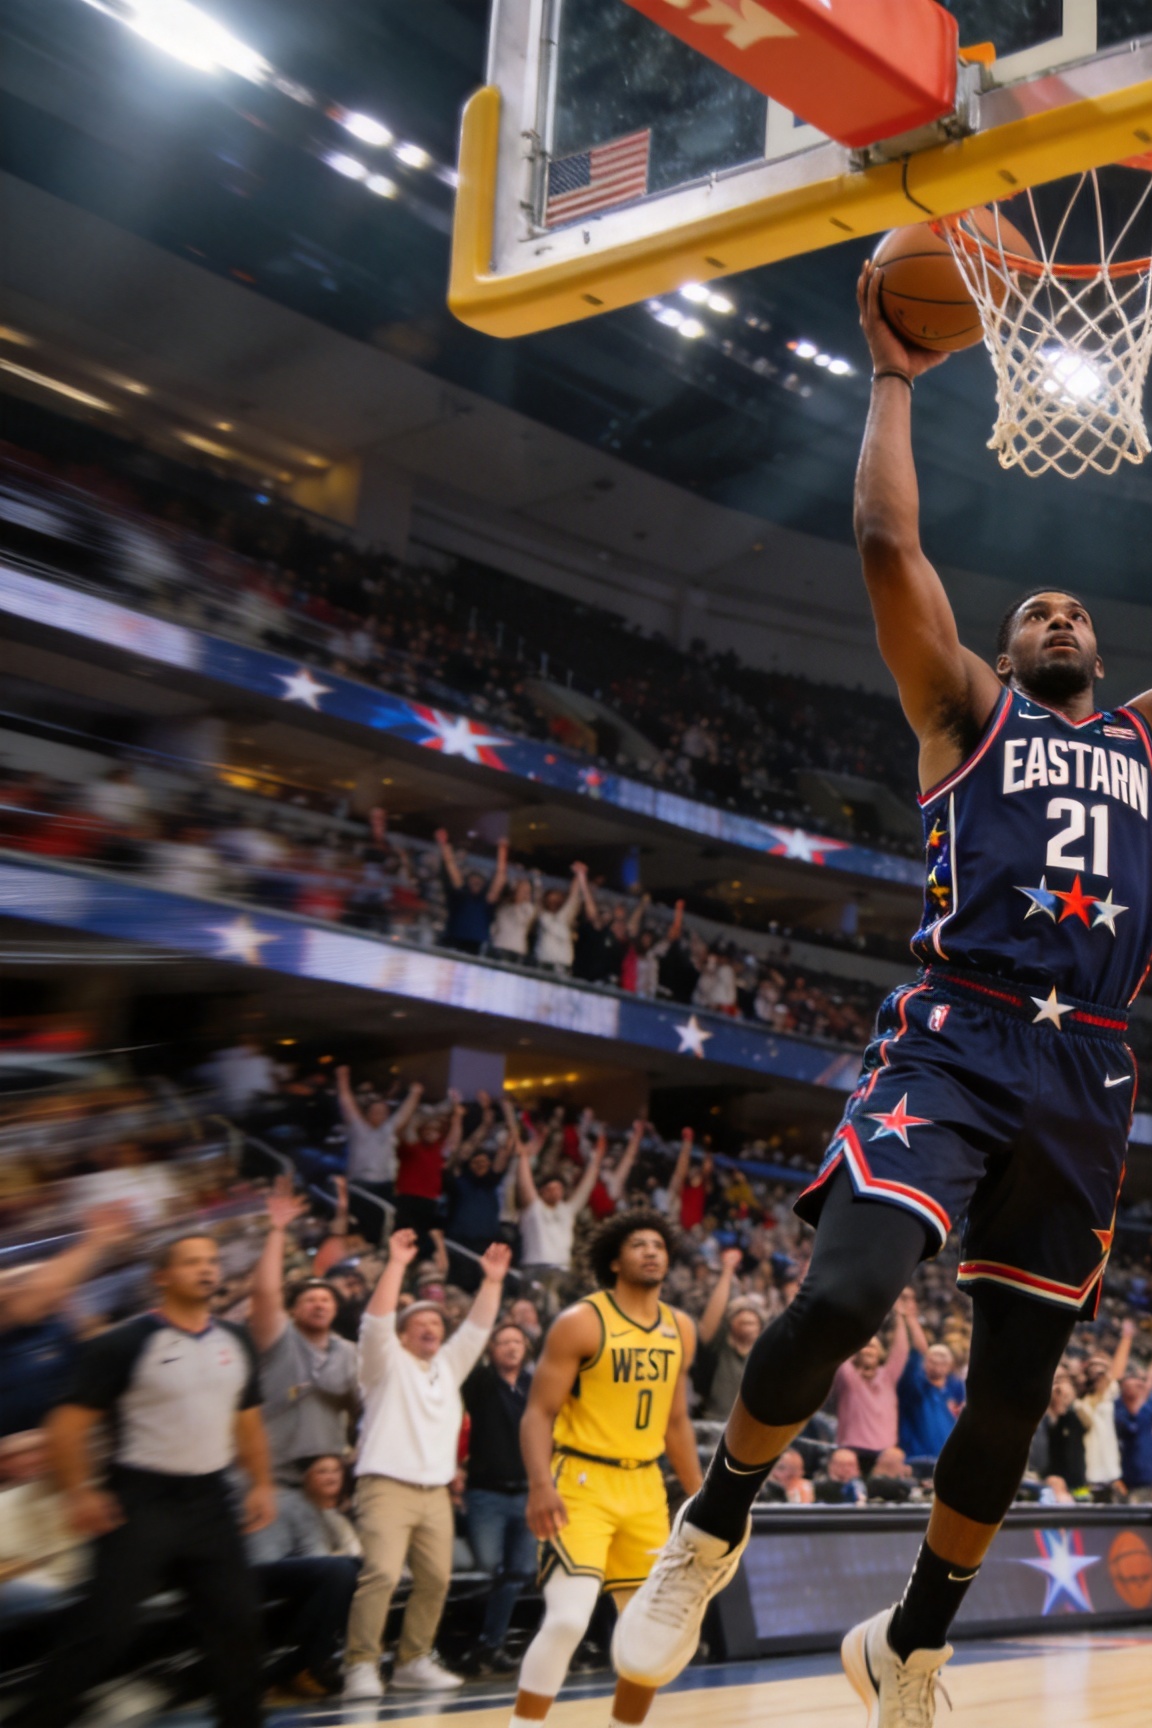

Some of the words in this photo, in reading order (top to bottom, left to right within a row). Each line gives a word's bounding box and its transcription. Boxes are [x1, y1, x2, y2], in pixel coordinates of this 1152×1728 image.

[1003, 737, 1148, 820] EASTARN
[1046, 797, 1109, 877] 21
[611, 1347, 676, 1383] WEST
[635, 1389, 653, 1430] 0
